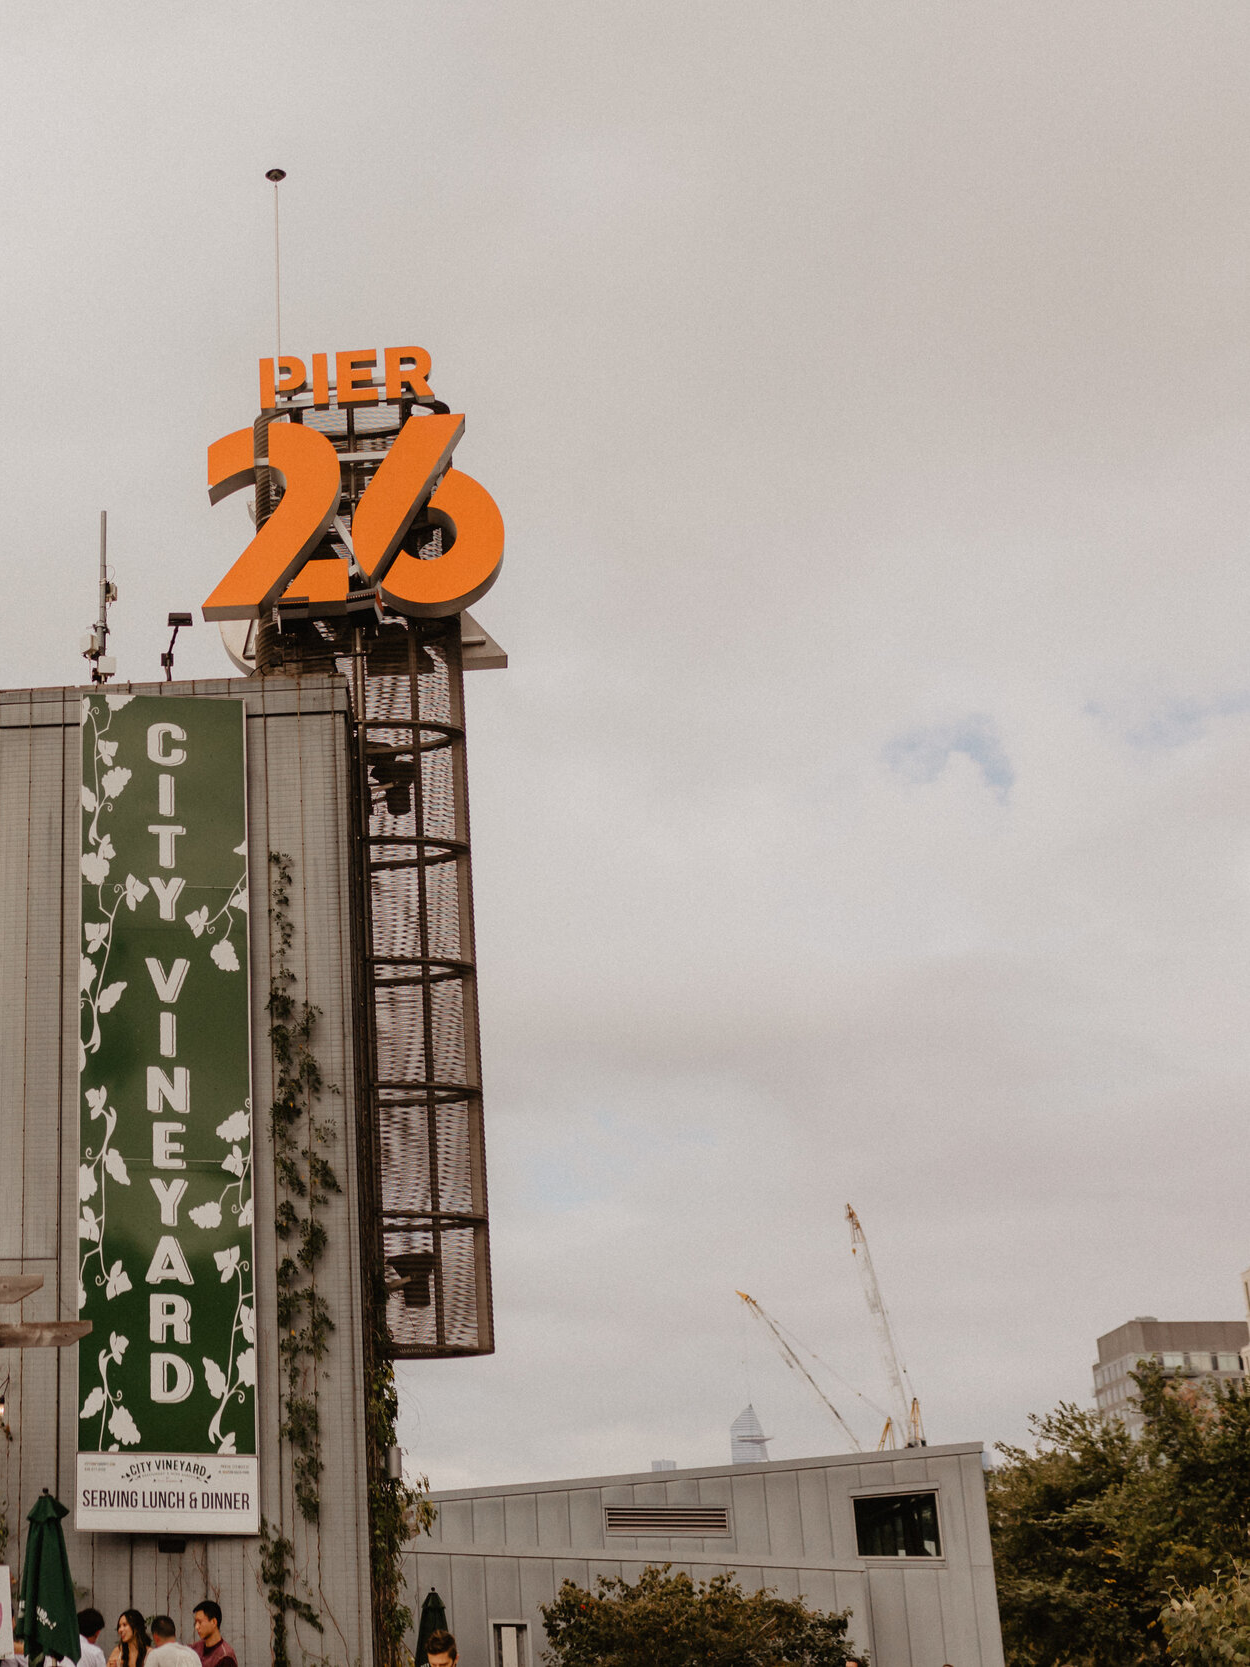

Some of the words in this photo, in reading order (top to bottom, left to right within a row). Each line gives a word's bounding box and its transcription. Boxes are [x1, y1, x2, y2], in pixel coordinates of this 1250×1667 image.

[259, 346, 435, 411] PIER
[202, 412, 505, 618] 26
[146, 722, 187, 921] CITY
[145, 957, 194, 1404] VINEYARD
[82, 1489, 138, 1508] SERVING
[142, 1491, 185, 1509] LUNCH
[189, 1491, 198, 1509] &
[201, 1492, 250, 1510] DINNER
[129, 1460, 152, 1476] CITY
[154, 1459, 207, 1477] VINEYARD
